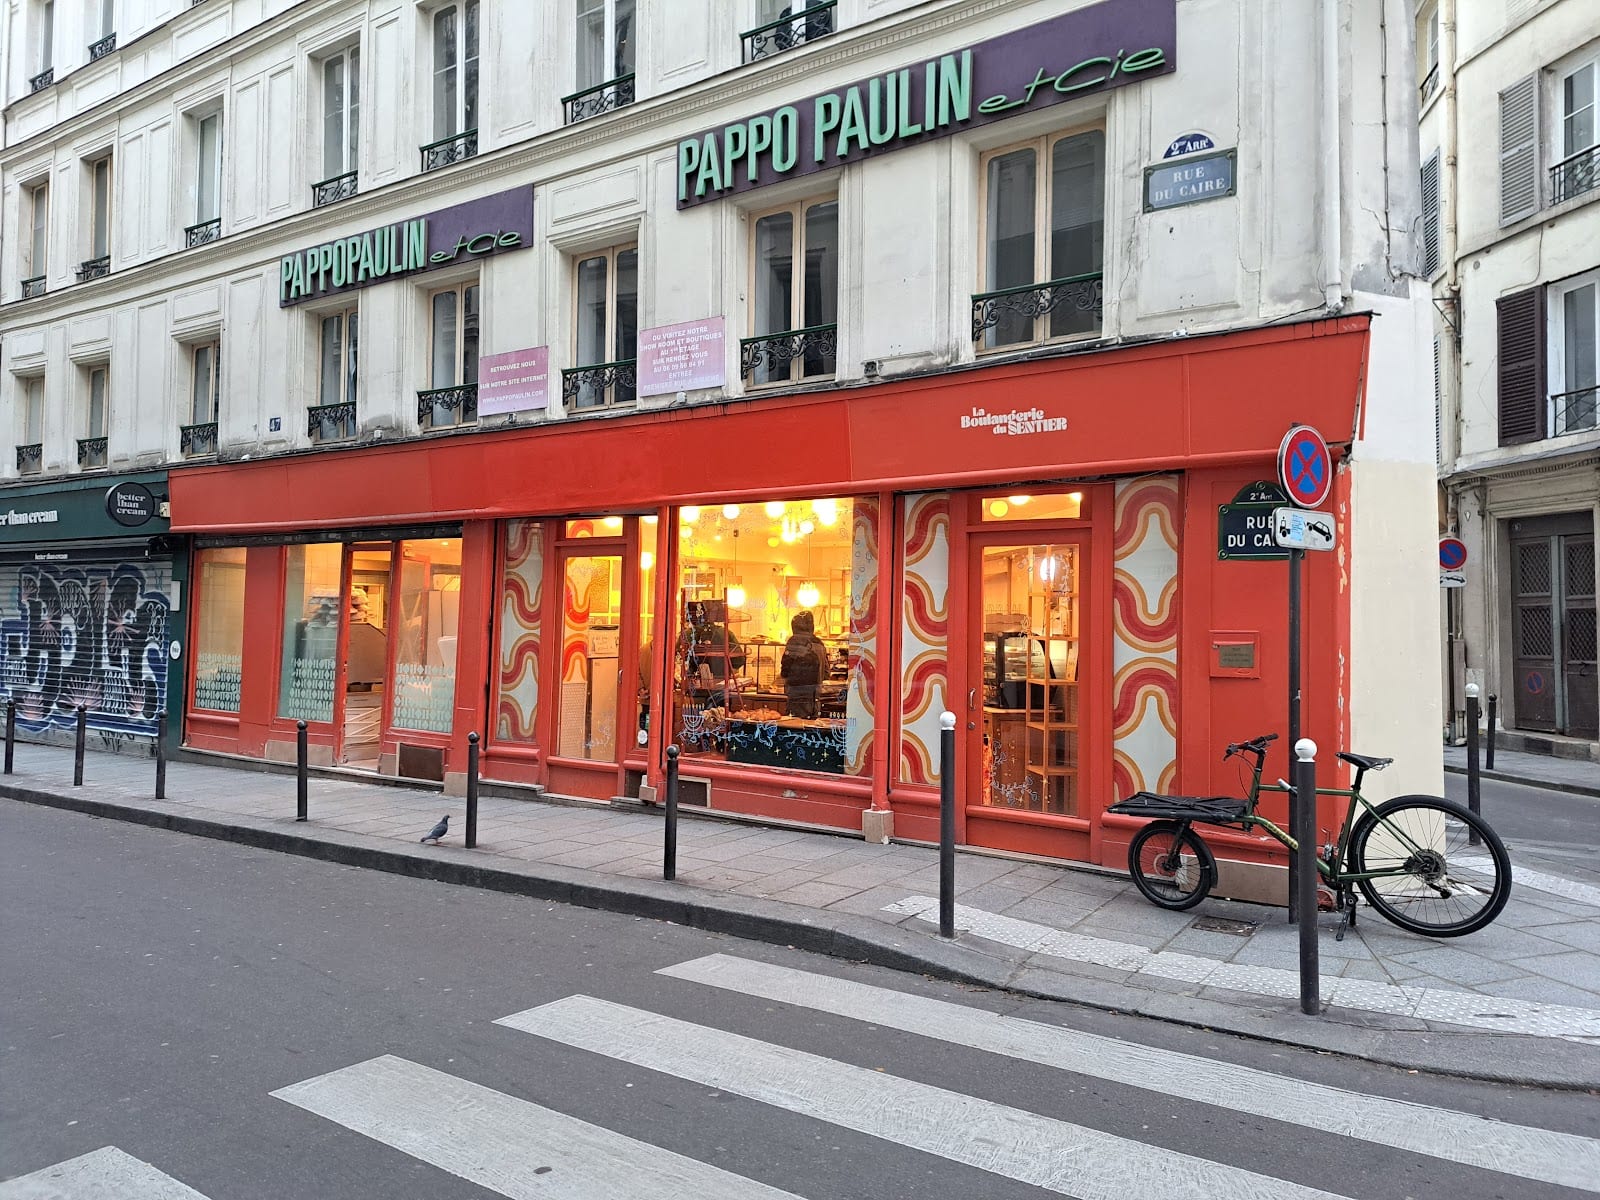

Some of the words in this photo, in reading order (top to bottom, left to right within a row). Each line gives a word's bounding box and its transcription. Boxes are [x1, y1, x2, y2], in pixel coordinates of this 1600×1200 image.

[678, 106, 799, 202] PAPPO
[814, 49, 974, 163] PAULIN
[1173, 166, 1205, 183] RUE
[1154, 189, 1173, 202] DU
[1180, 177, 1225, 197] CAIRE
[658, 340, 676, 348] ROOM
[677, 338, 684, 346] ET
[686, 331, 722, 344] BOUTIQUES
[662, 329, 686, 340] VISITEZ
[687, 326, 708, 335] NOTRE
[666, 354, 690, 363] RENDEZ
[691, 350, 709, 359] VOUS
[490, 362, 520, 373] RETROUVEZ
[490, 380, 508, 388] NOTRE
[508, 377, 520, 385] SITE
[520, 374, 547, 383] INTERNET
[960, 407, 1045, 428] Boulangerie
[972, 407, 985, 417] La
[992, 424, 1007, 435] du
[1007, 417, 1067, 435] SENTIER
[116, 491, 146, 502] better
[117, 499, 139, 509] than
[116, 507, 147, 516] cream
[1227, 534, 1246, 548] DU
